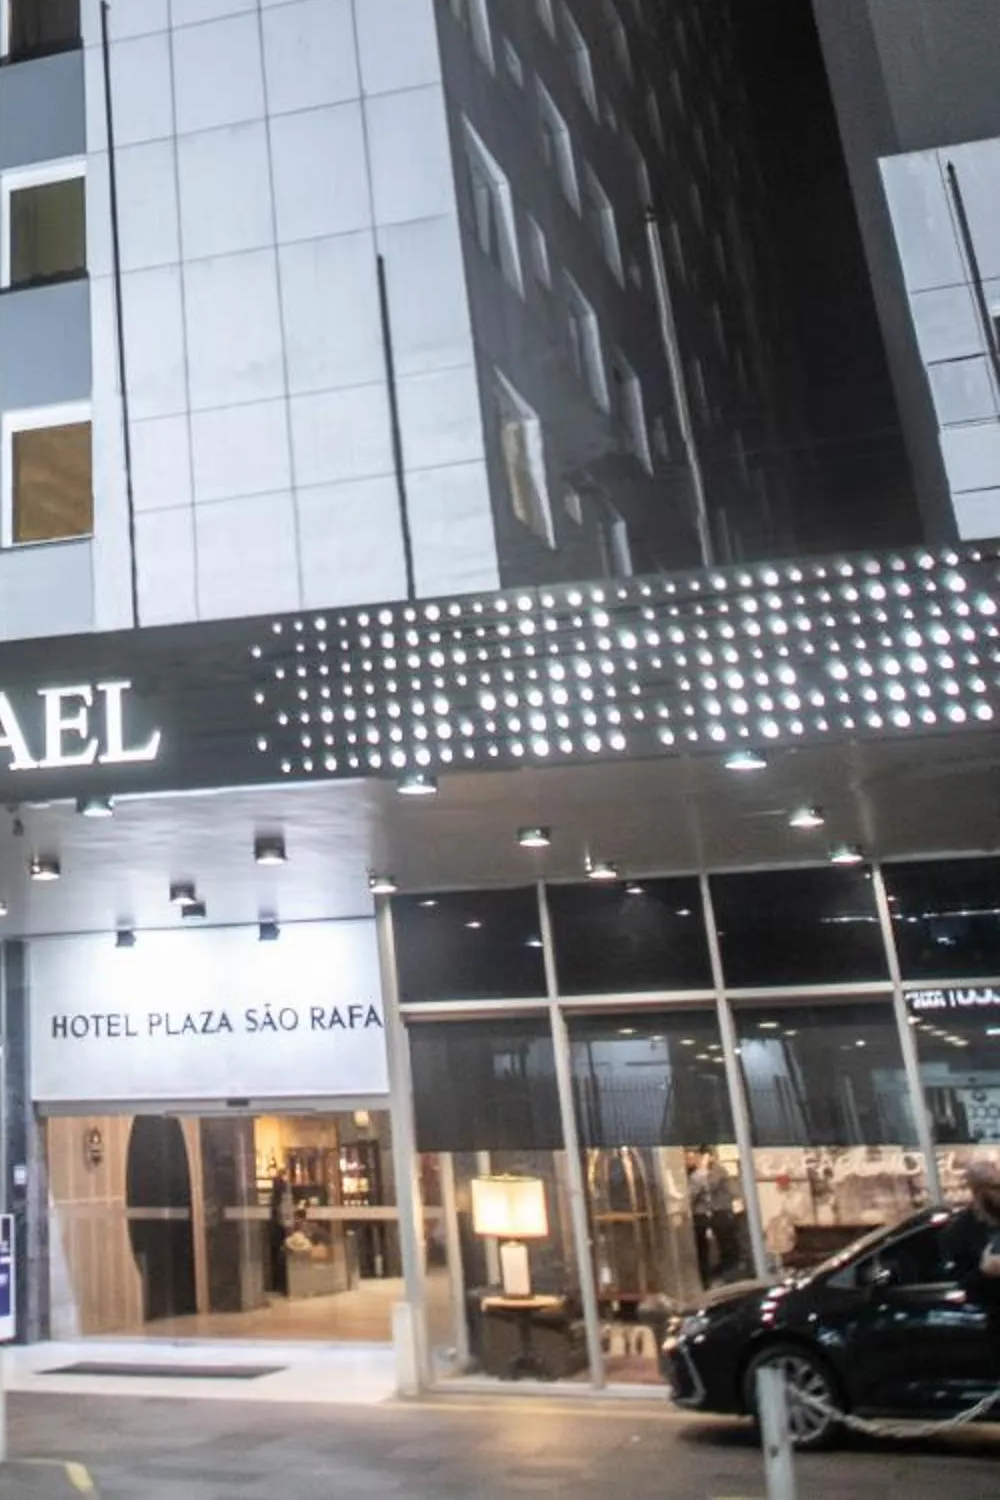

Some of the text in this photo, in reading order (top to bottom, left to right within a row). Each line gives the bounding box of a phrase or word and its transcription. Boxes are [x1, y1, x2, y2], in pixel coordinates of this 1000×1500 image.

[51, 1003, 386, 1038] HOTEL PLAZA SÃO RAFA
